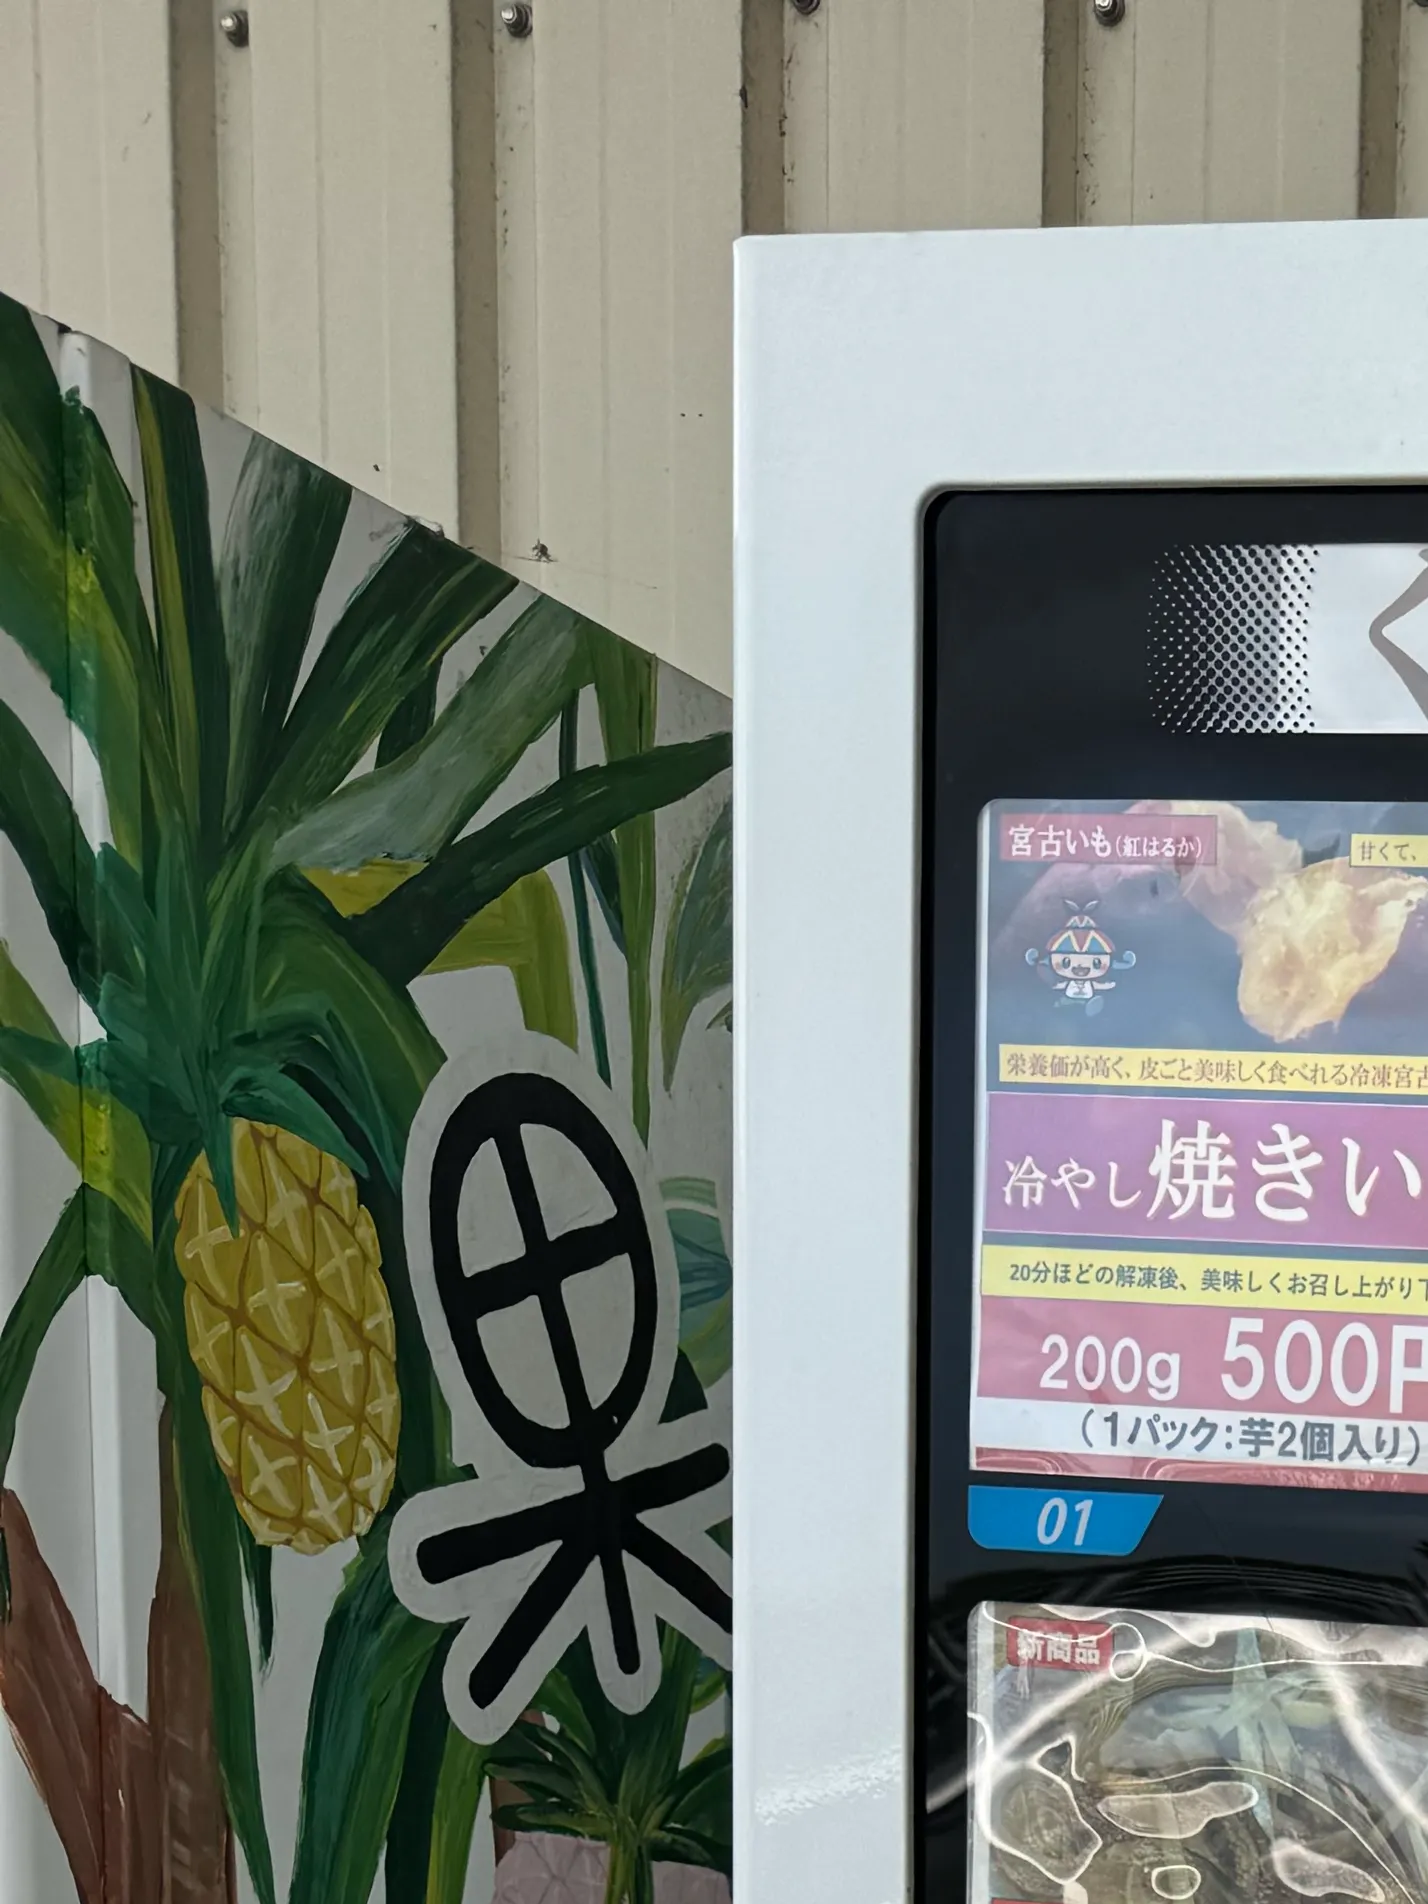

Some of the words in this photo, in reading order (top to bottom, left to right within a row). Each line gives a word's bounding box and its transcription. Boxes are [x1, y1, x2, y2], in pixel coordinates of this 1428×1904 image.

[1008, 824, 1203, 859] 宮古いも(紅はるか)
[1039, 1334, 1181, 1398] 200g
[1036, 1497, 1093, 1547] 01
